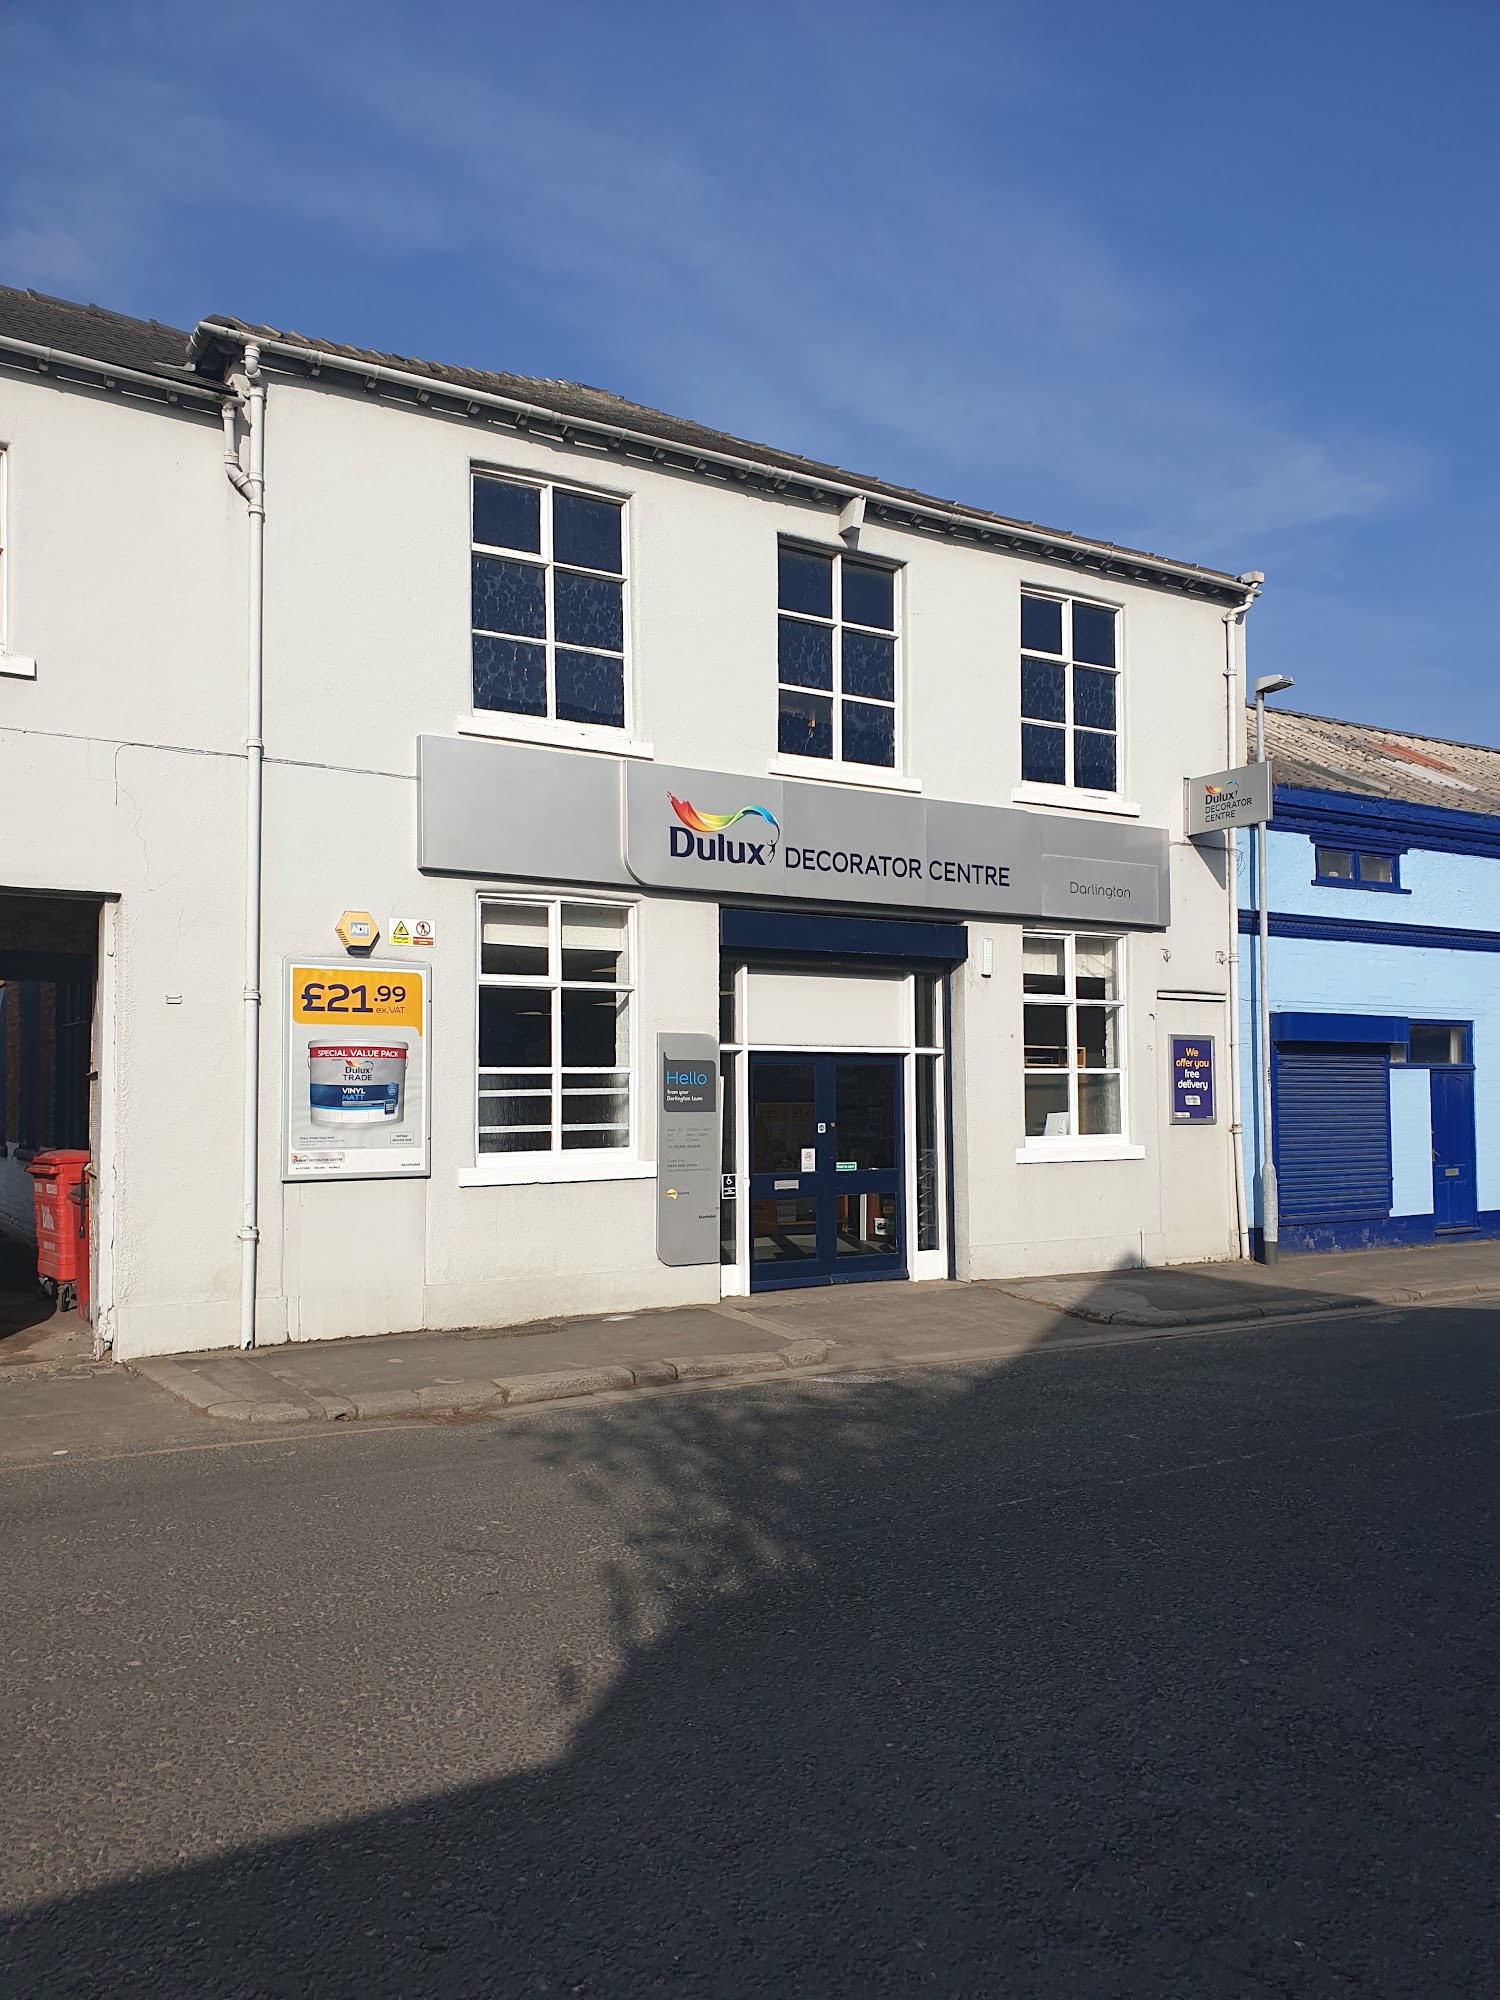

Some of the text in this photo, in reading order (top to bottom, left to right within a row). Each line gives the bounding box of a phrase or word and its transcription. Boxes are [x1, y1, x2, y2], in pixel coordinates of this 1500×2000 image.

[1205, 792, 1235, 805] Dulux
[1205, 797, 1252, 814] DECORATOR
[1205, 810, 1236, 823] CENTRE
[669, 826, 1011, 887] Dulux DECORATOR CENTRE
[1069, 881, 1132, 899] Darlington
[351, 924, 369, 935] ADT
[317, 1049, 399, 1058] SPECIAL VALUE PACK
[1185, 1047, 1199, 1057] We
[345, 1066, 371, 1074] Dulux
[1176, 1058, 1210, 1070] offer you
[666, 1071, 707, 1085] Hello
[1184, 1069, 1200, 1078] free
[1177, 1080, 1208, 1091] delivery
